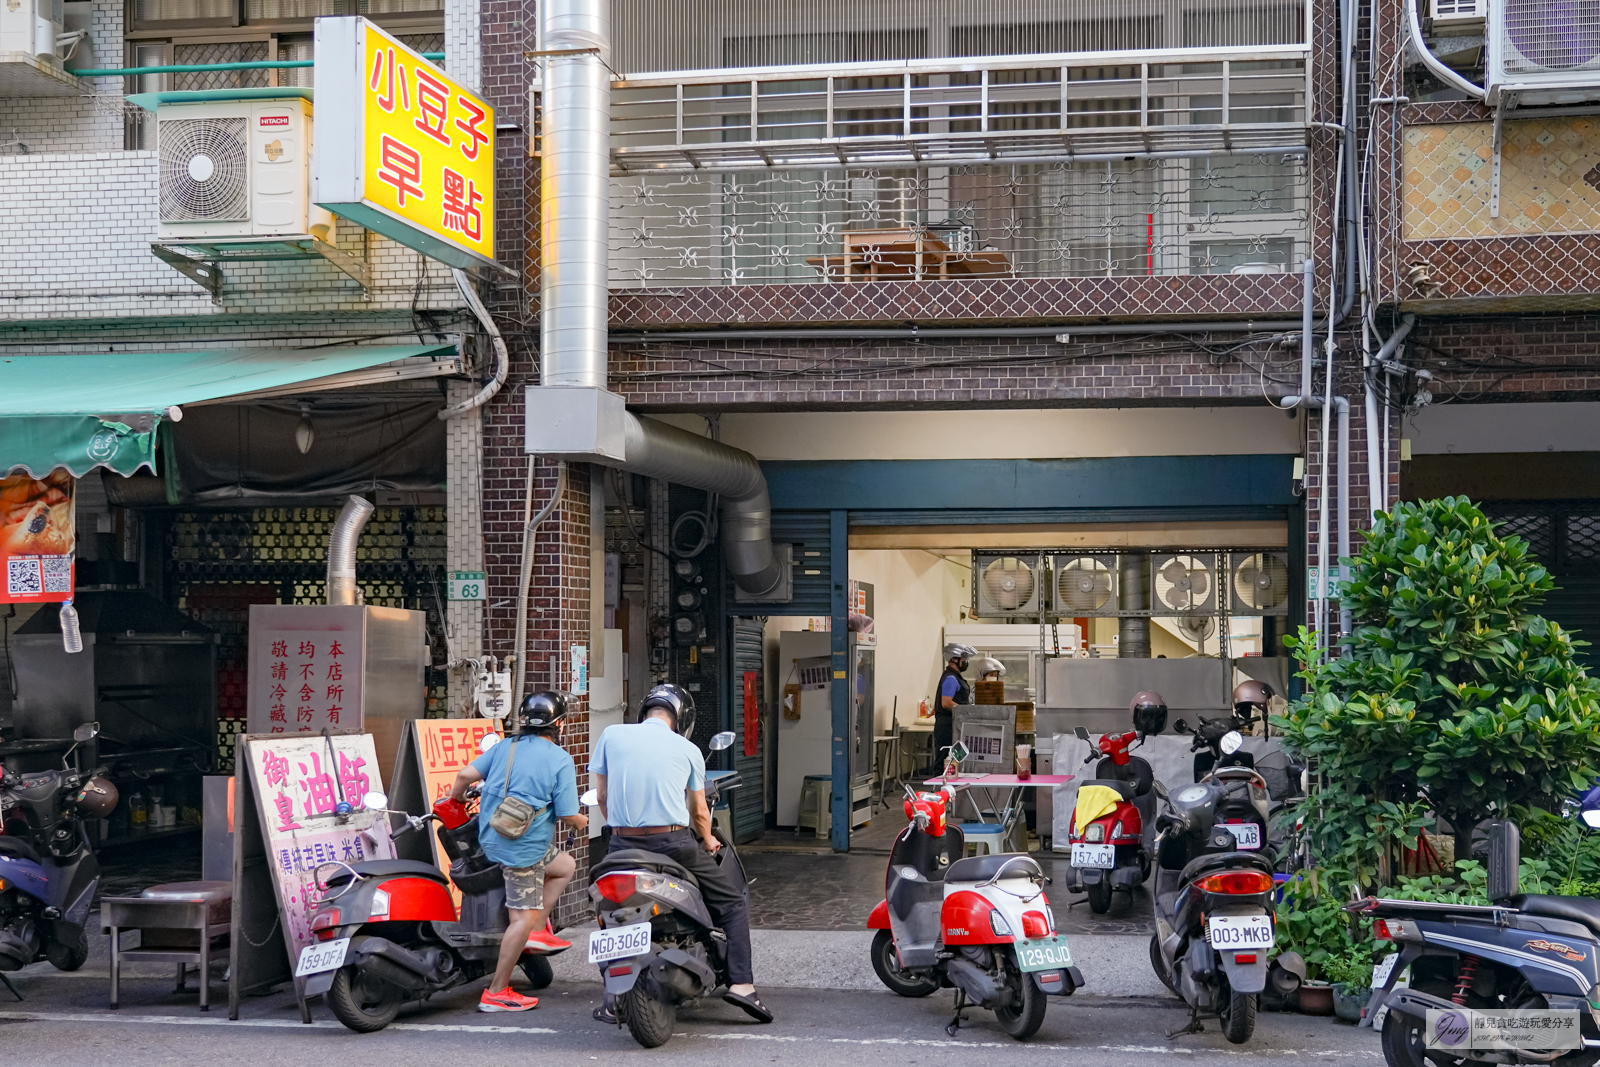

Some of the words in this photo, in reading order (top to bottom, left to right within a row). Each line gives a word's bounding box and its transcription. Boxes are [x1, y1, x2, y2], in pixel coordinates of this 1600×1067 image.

[370, 47, 489, 161] 小豆子
[377, 133, 483, 243] 早點
[461, 584, 479, 598] 63
[297, 640, 316, 732] 均不含防
[326, 640, 345, 729] 本店所有
[297, 750, 370, 820] 油飯
[424, 726, 500, 768] 小豆子早
